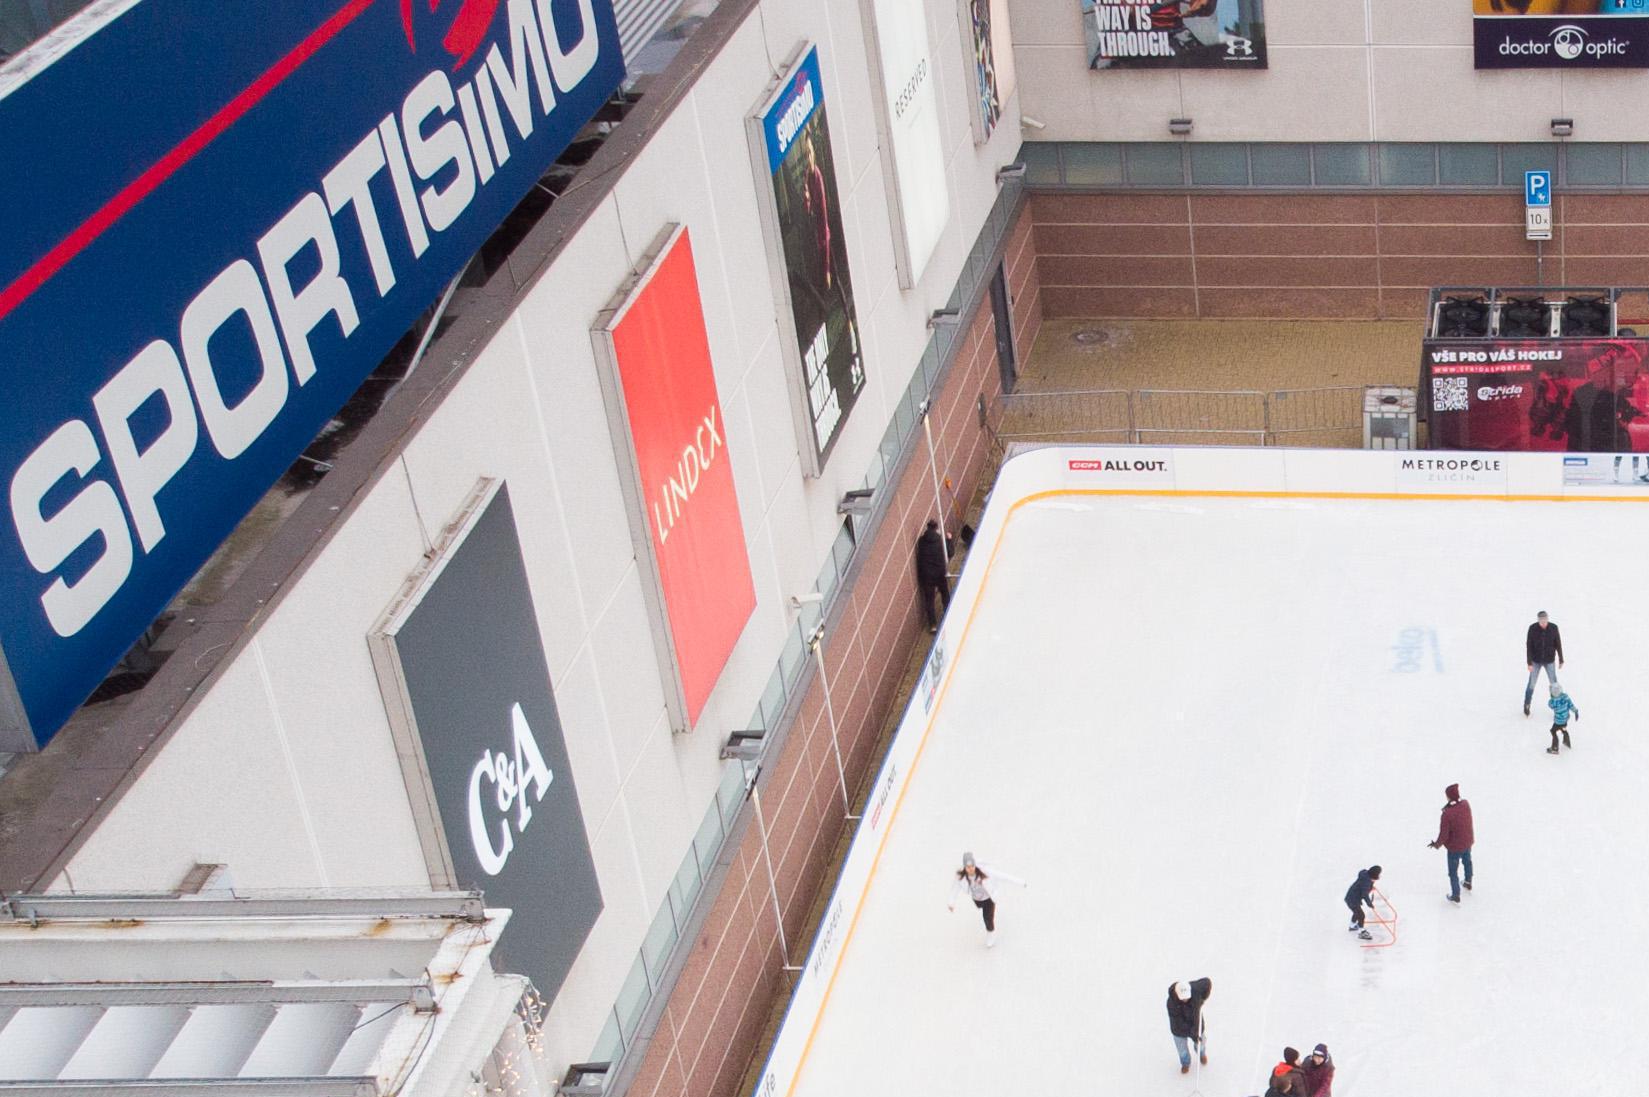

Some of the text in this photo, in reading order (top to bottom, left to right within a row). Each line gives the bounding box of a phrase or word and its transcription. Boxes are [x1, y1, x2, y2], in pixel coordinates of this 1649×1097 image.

[1095, 5, 1153, 31] WAY IS
[1098, 32, 1176, 57] THROUGH.
[1498, 35, 1551, 55] doctor
[894, 57, 927, 120] RESERVED
[1530, 175, 1546, 196] P
[10, 0, 600, 638] SPORTISIMO
[1431, 348, 1563, 363] VŠE PRO VÁŠ HOKEJ
[653, 404, 724, 546] LINDEX
[1104, 460, 1132, 471] ALL
[1401, 459, 1501, 471] METROPOLE
[468, 701, 553, 876] C&A
